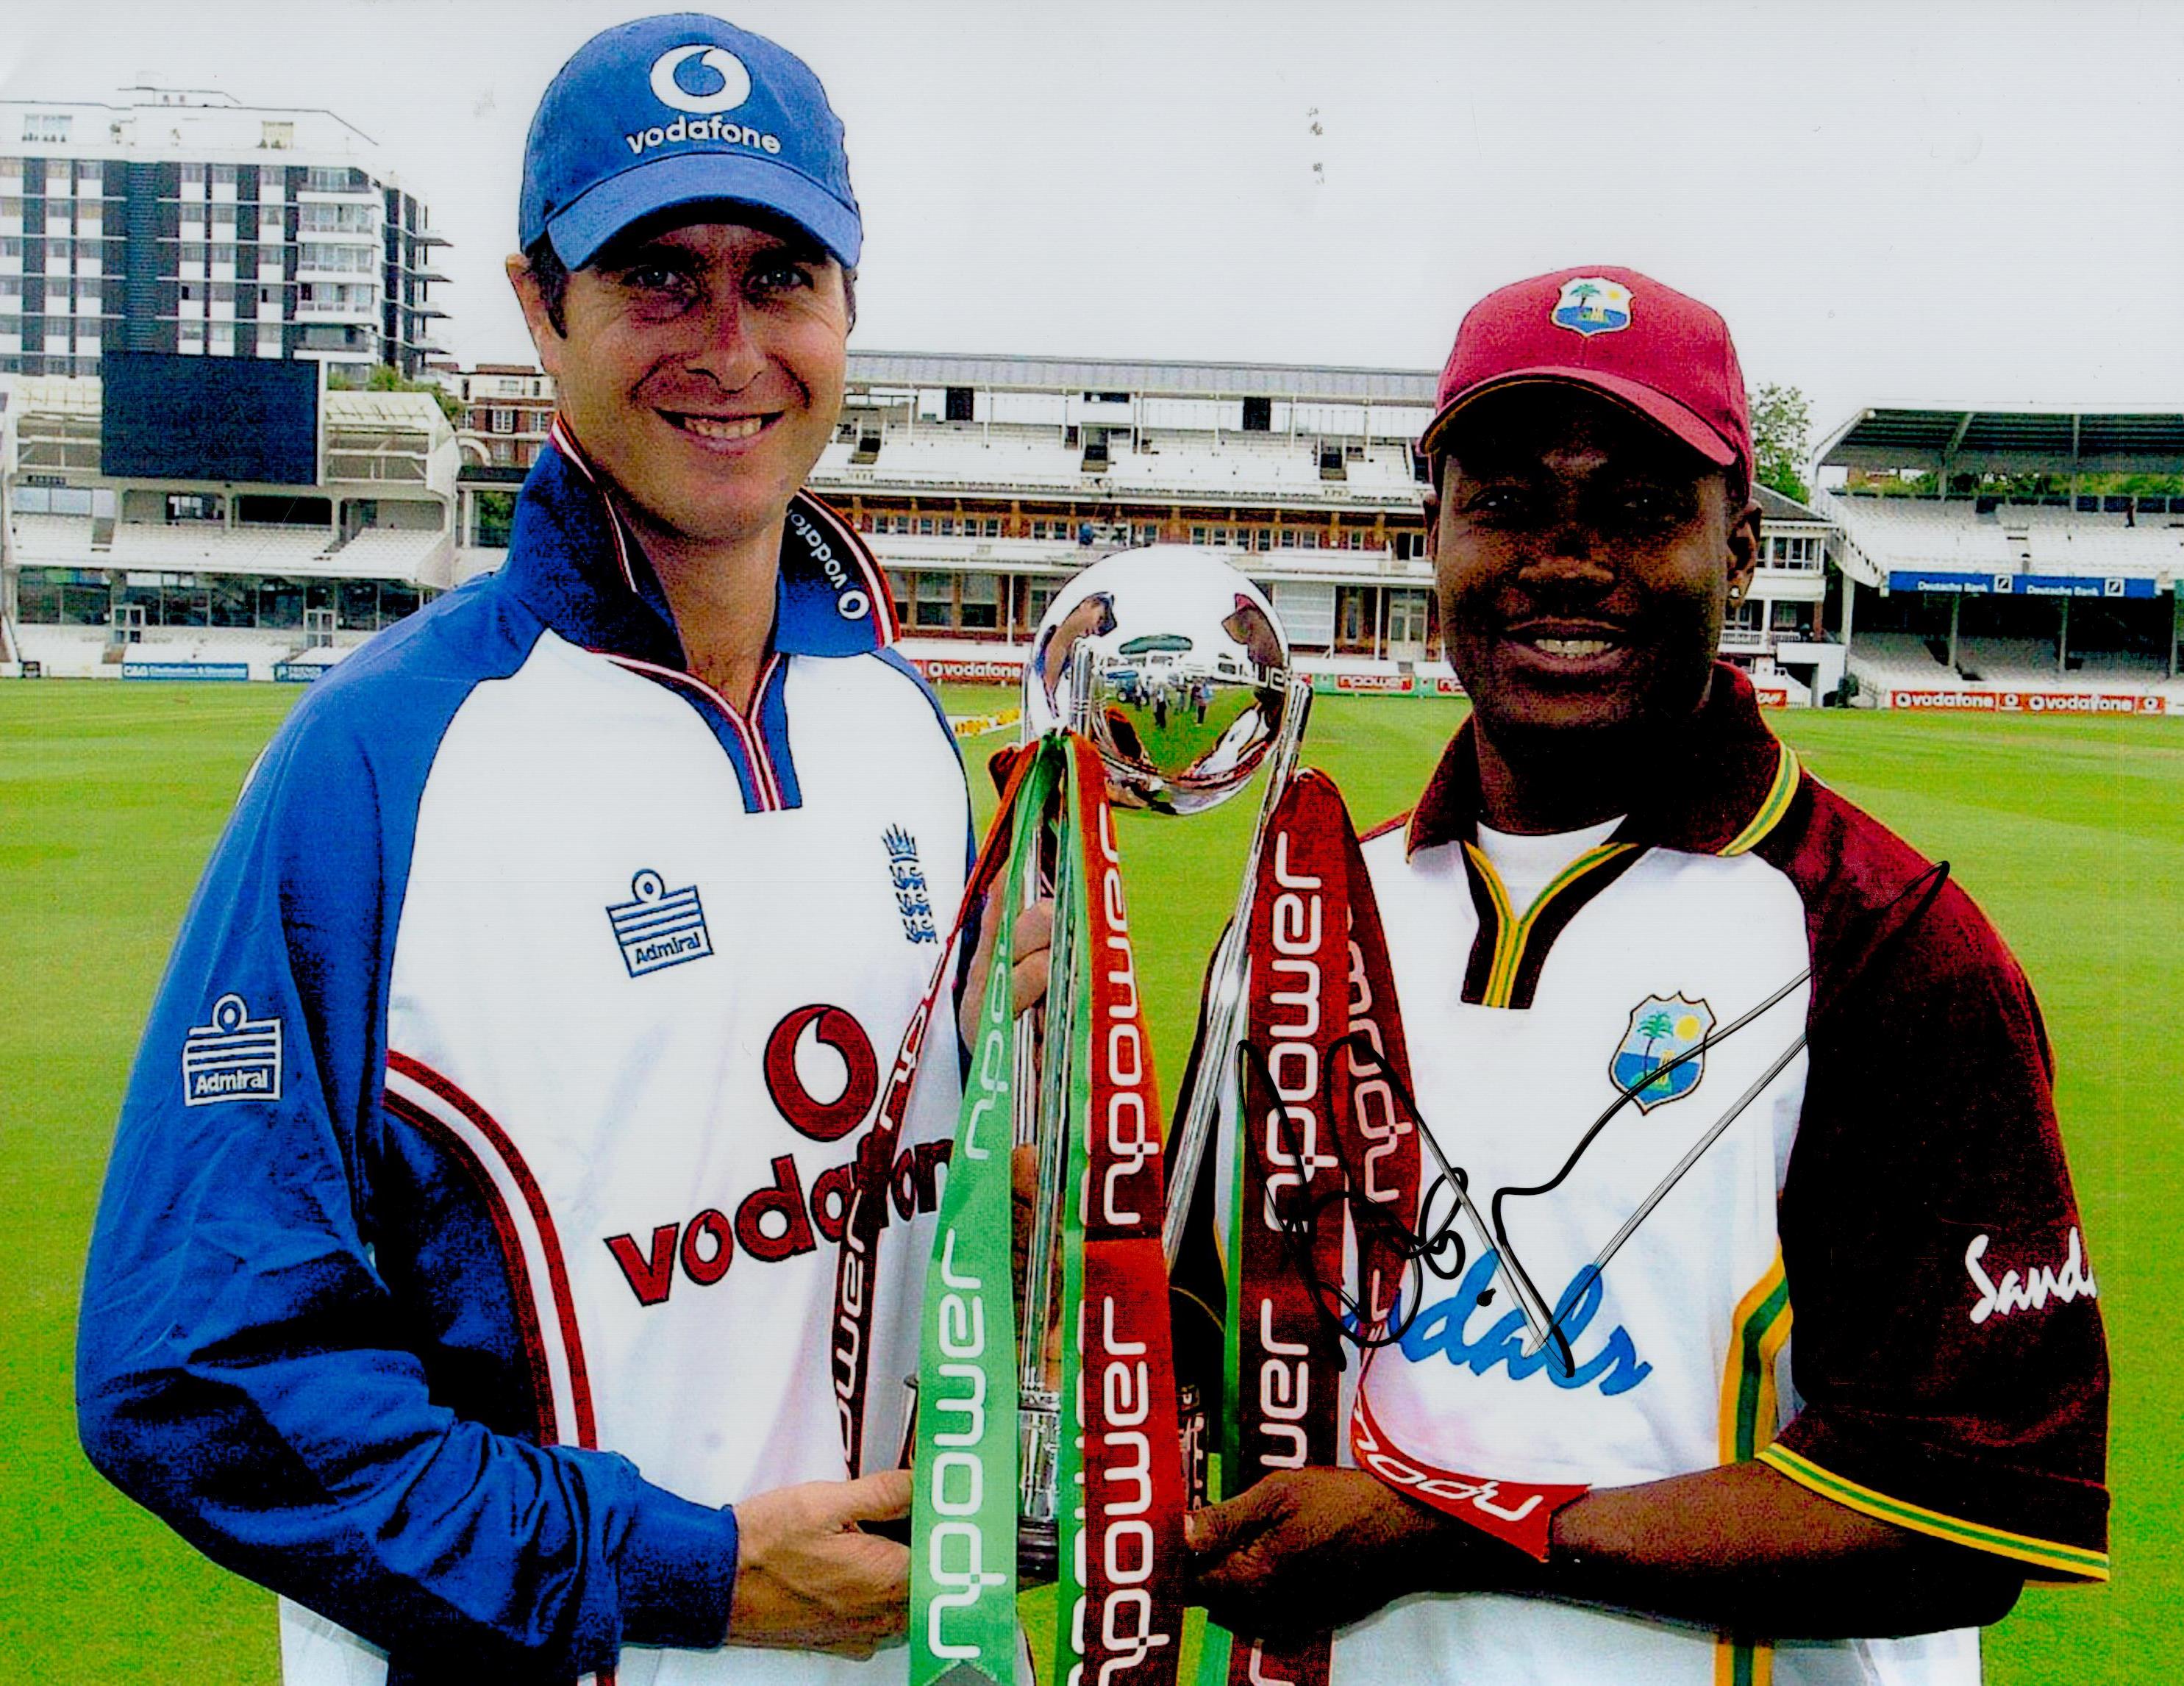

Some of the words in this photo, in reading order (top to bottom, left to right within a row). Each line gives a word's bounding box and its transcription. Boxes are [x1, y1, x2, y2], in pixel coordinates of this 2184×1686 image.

[626, 115, 781, 154] vodafone
[788, 507, 848, 589] vodafo
[943, 662, 1021, 677] vodafone
[1913, 693, 1994, 707] vodafone
[2046, 694, 2132, 711] vodafone
[635, 932, 701, 965] Admiral
[1099, 801, 1160, 1226] npower
[195, 1068, 268, 1095] Admiral
[927, 1226, 1007, 1660] npower
